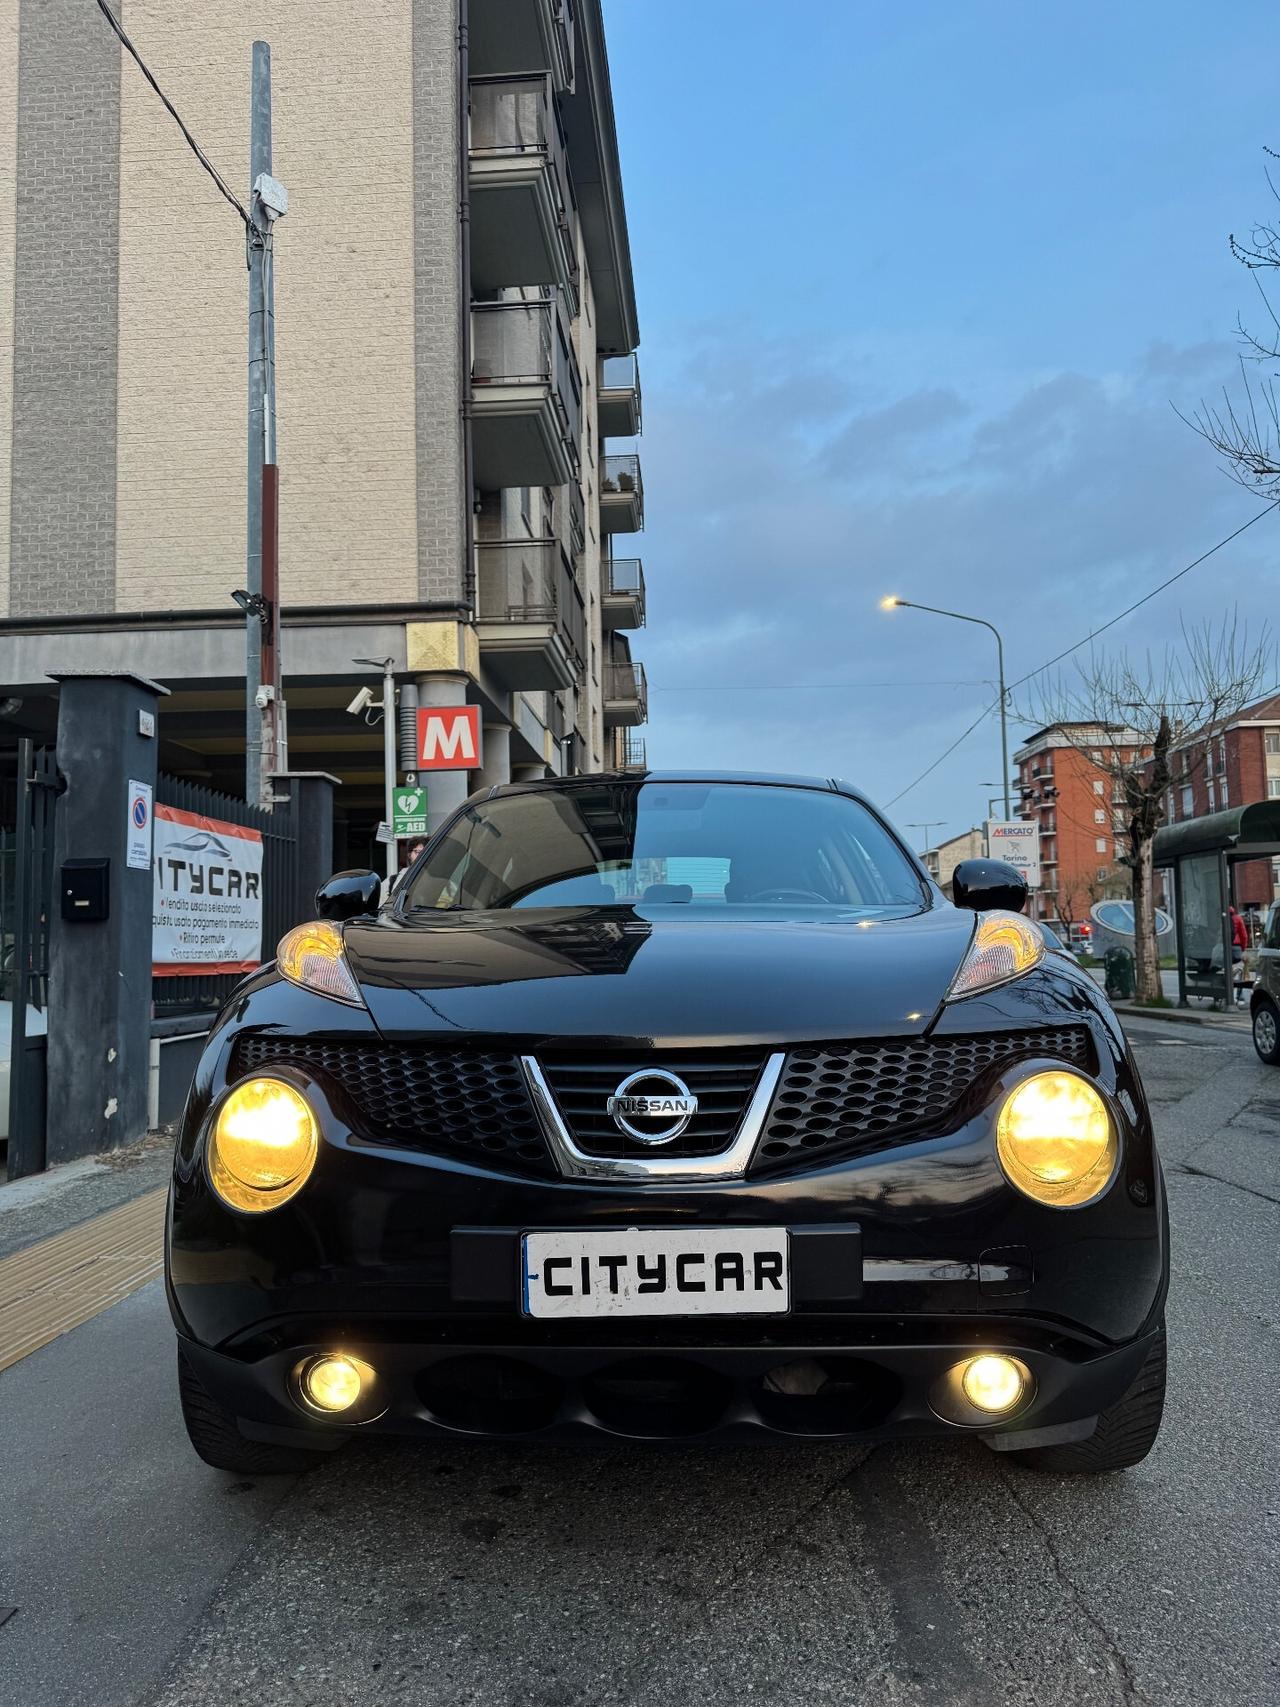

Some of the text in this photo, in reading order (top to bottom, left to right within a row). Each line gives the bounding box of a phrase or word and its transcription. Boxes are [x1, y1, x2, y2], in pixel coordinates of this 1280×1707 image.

[422, 716, 475, 760] M
[406, 822, 426, 832] AED
[154, 857, 259, 899] ITYCAR
[190, 899, 208, 912] usato
[208, 900, 241, 914] selezionato
[174, 915, 191, 928] usato
[192, 918, 227, 930] pagamento
[228, 918, 259, 929] immediato
[200, 935, 226, 947] permute
[616, 1099, 688, 1113] NISSAN
[543, 1251, 784, 1296] CITYCAR
